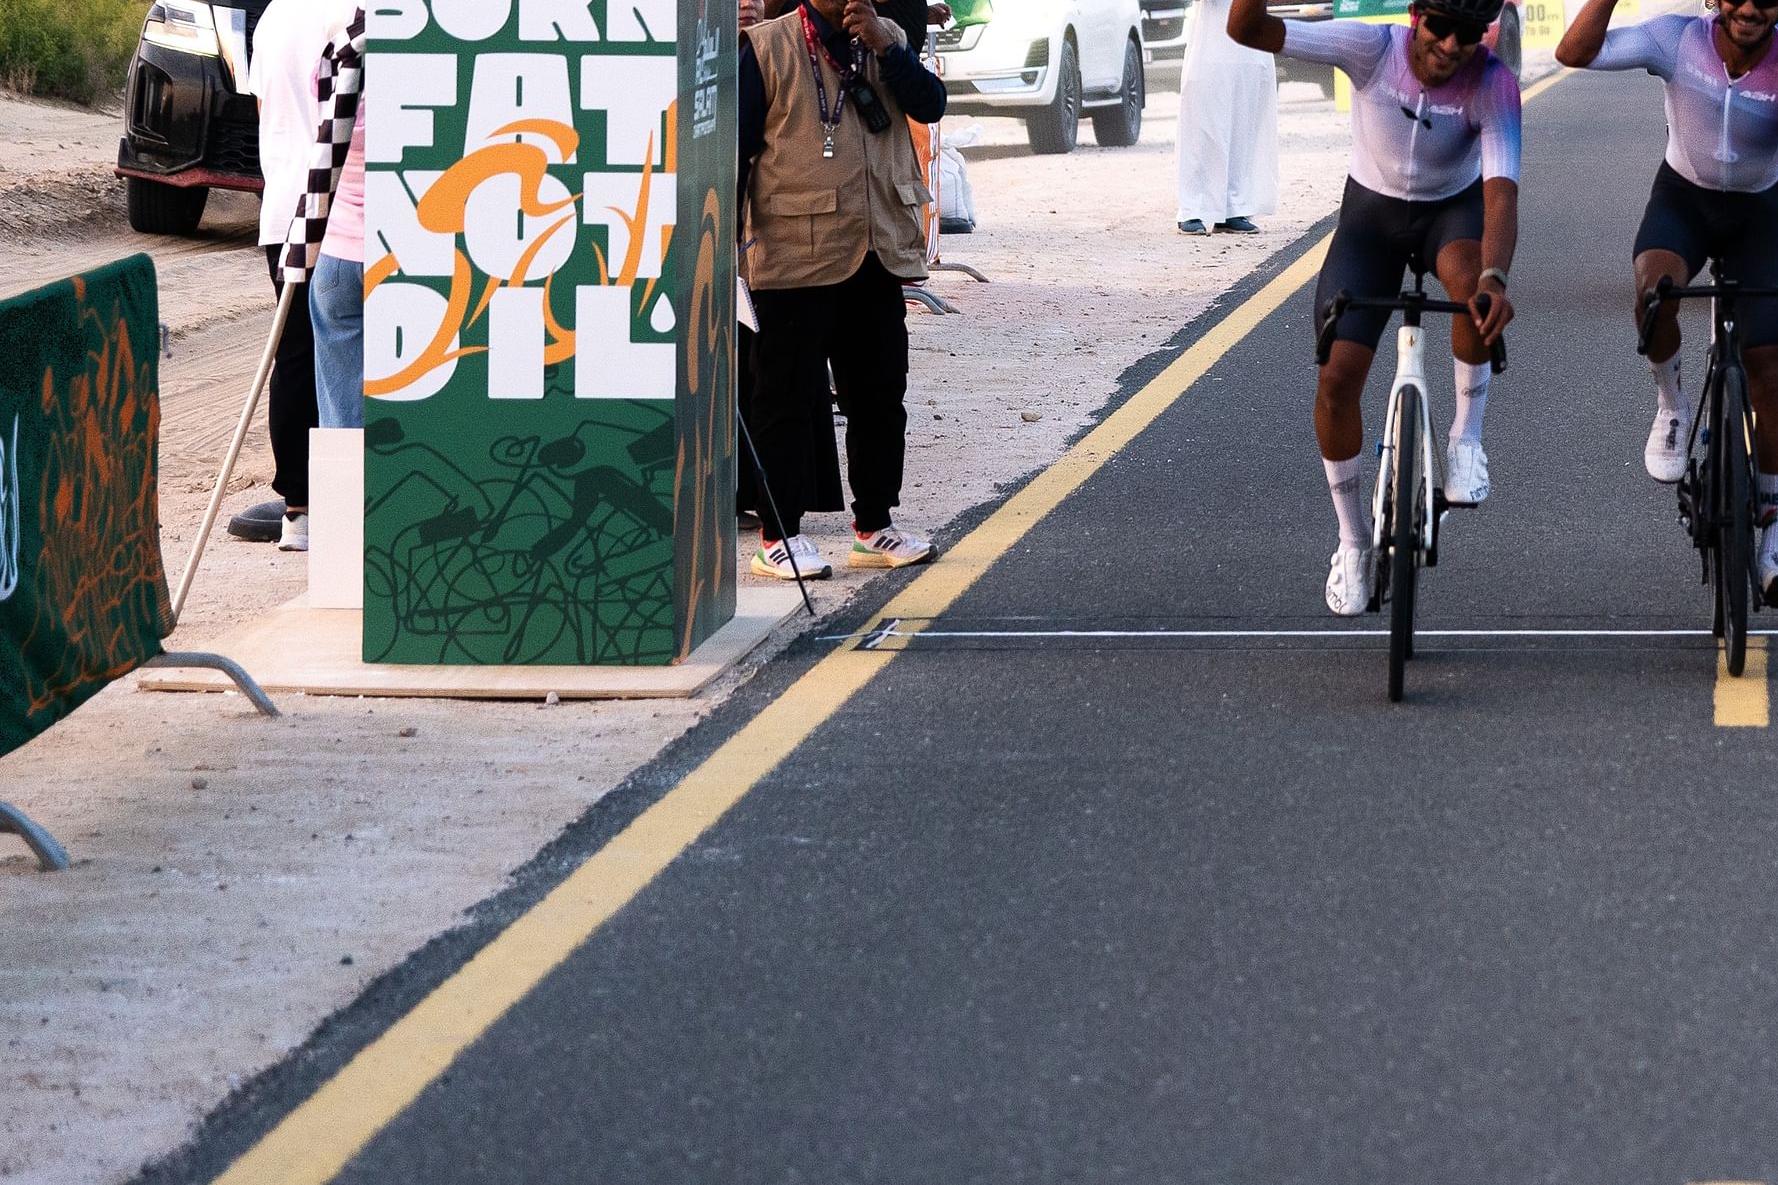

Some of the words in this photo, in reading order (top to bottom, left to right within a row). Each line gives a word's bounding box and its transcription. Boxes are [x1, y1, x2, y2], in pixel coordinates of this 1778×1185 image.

[363, 53, 676, 165] FAT
[363, 172, 676, 278] NOT
[363, 283, 676, 400] OIL
